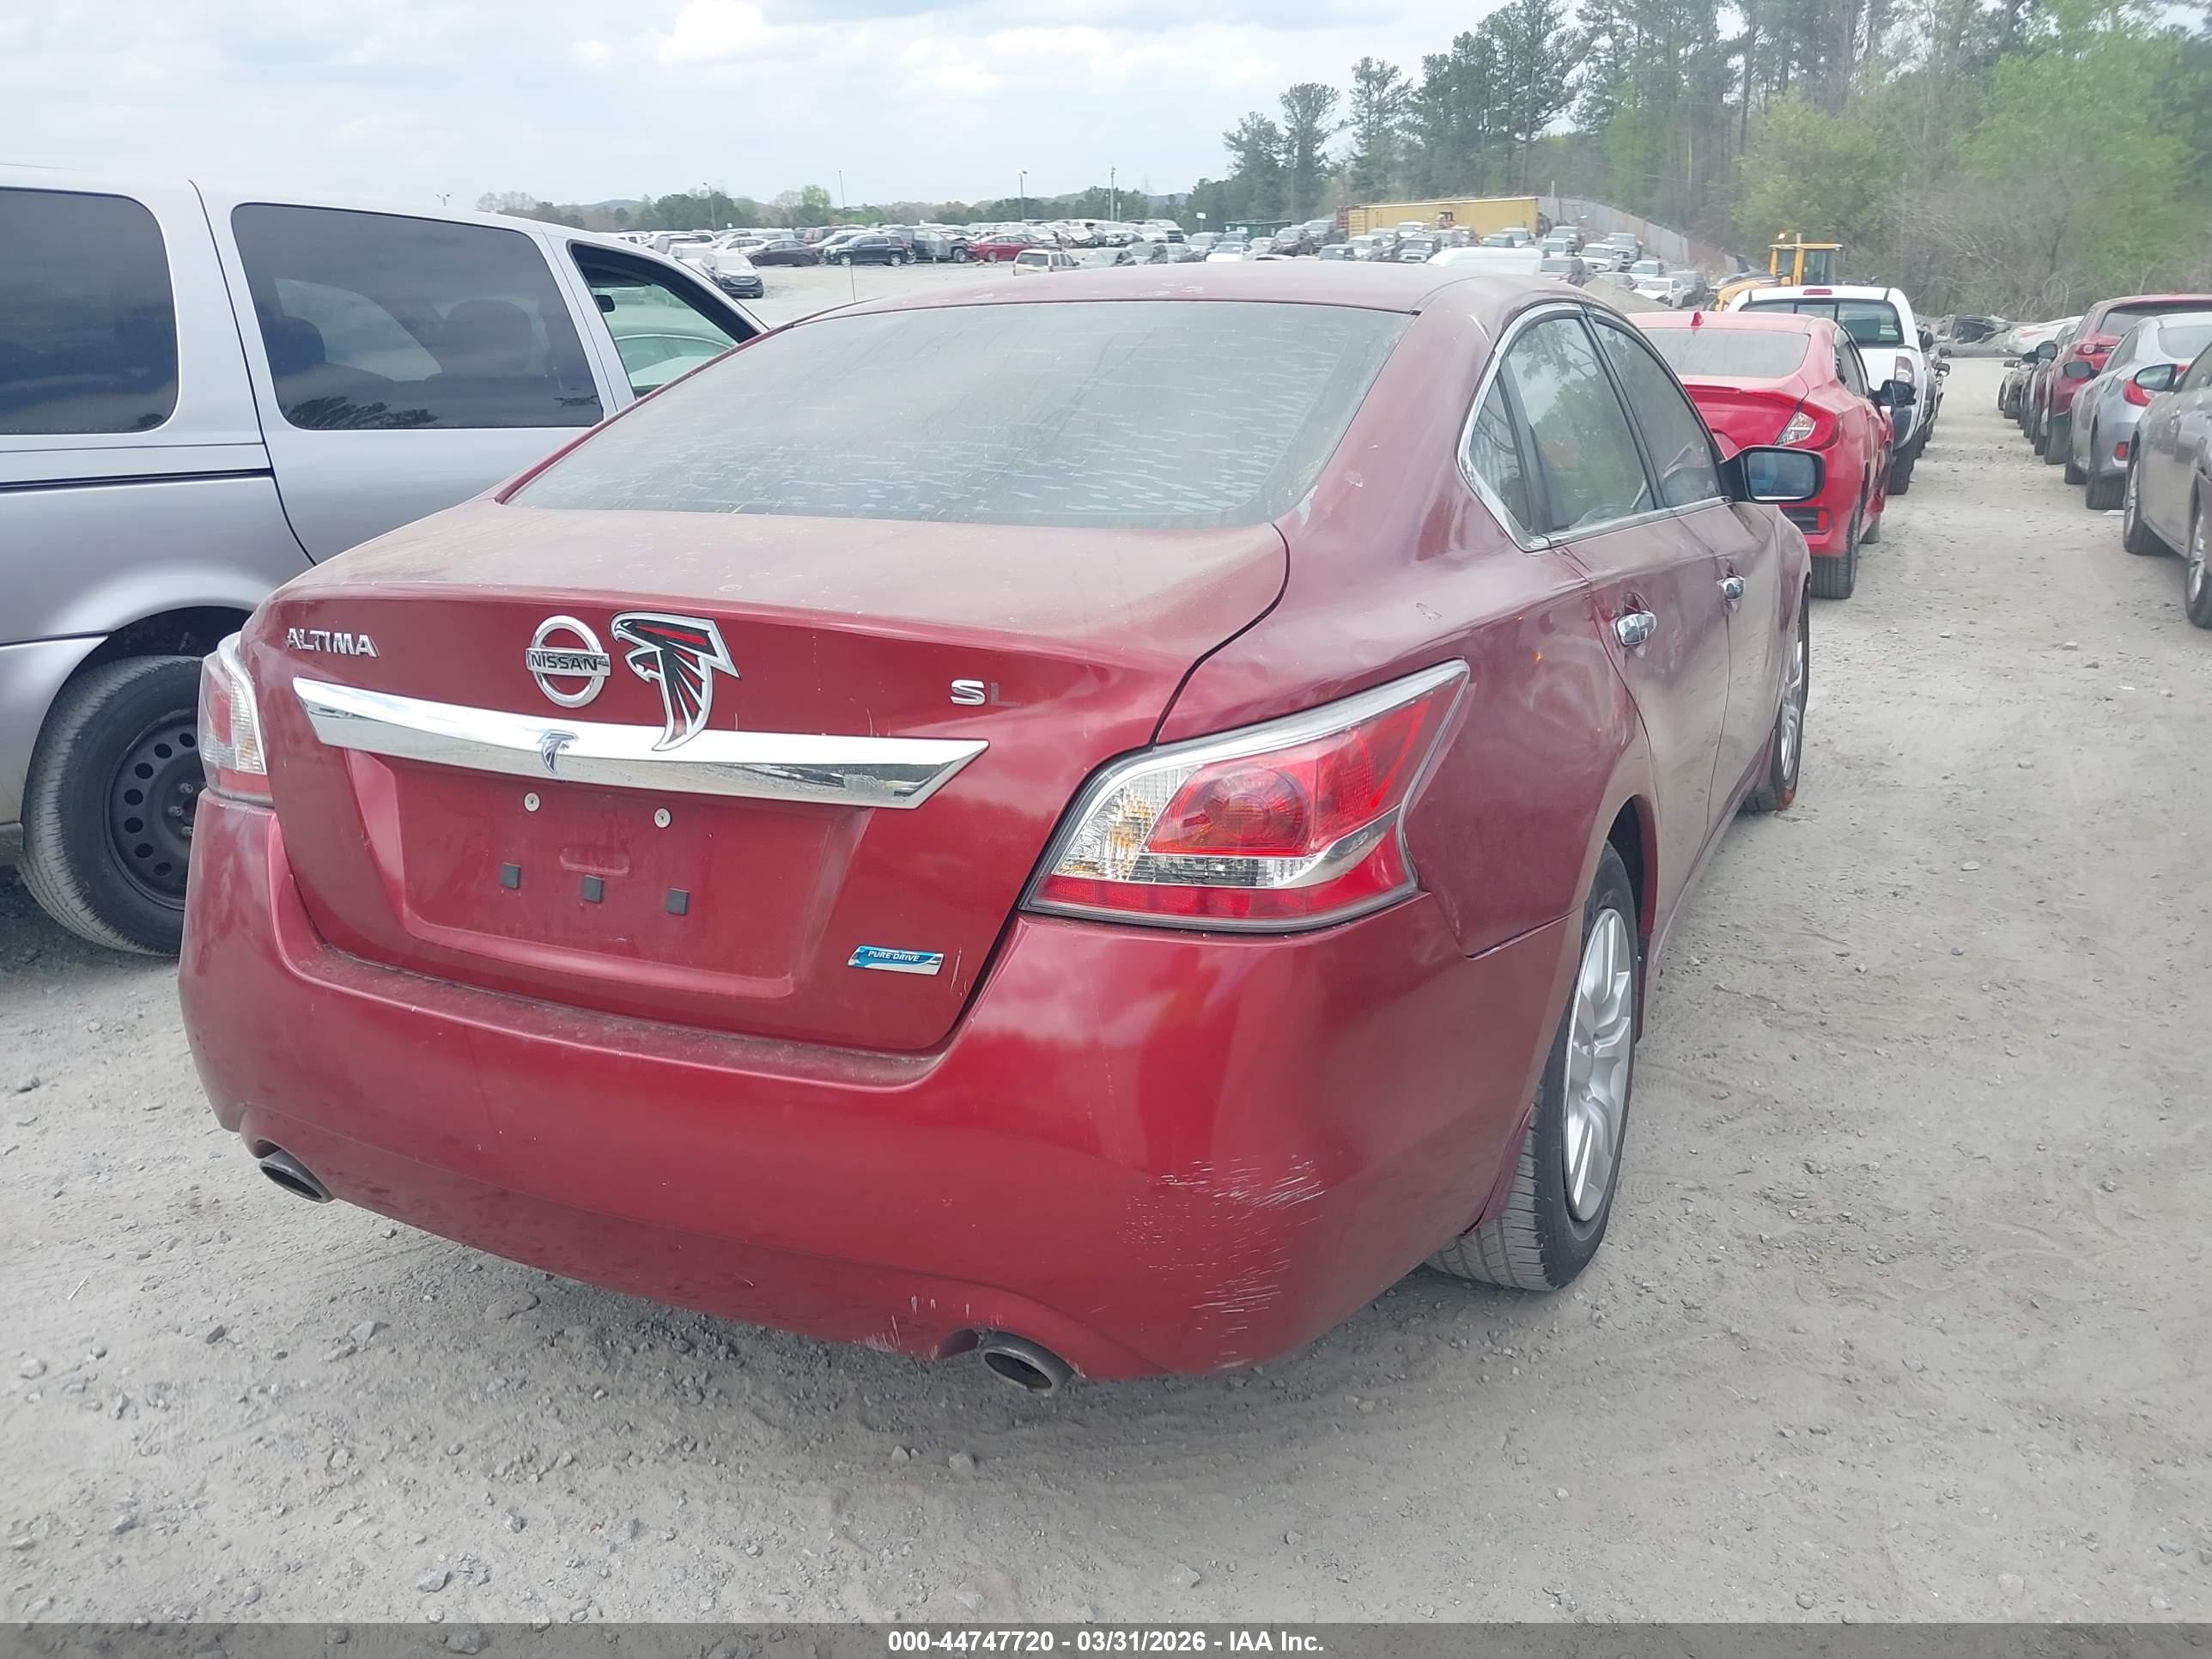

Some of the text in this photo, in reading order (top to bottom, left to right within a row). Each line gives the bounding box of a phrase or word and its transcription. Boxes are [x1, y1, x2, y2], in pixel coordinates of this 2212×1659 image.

[287, 628, 380, 658] ALTIMA
[531, 653, 599, 672] NISSAN
[867, 950, 921, 962] PURE DRIVE
